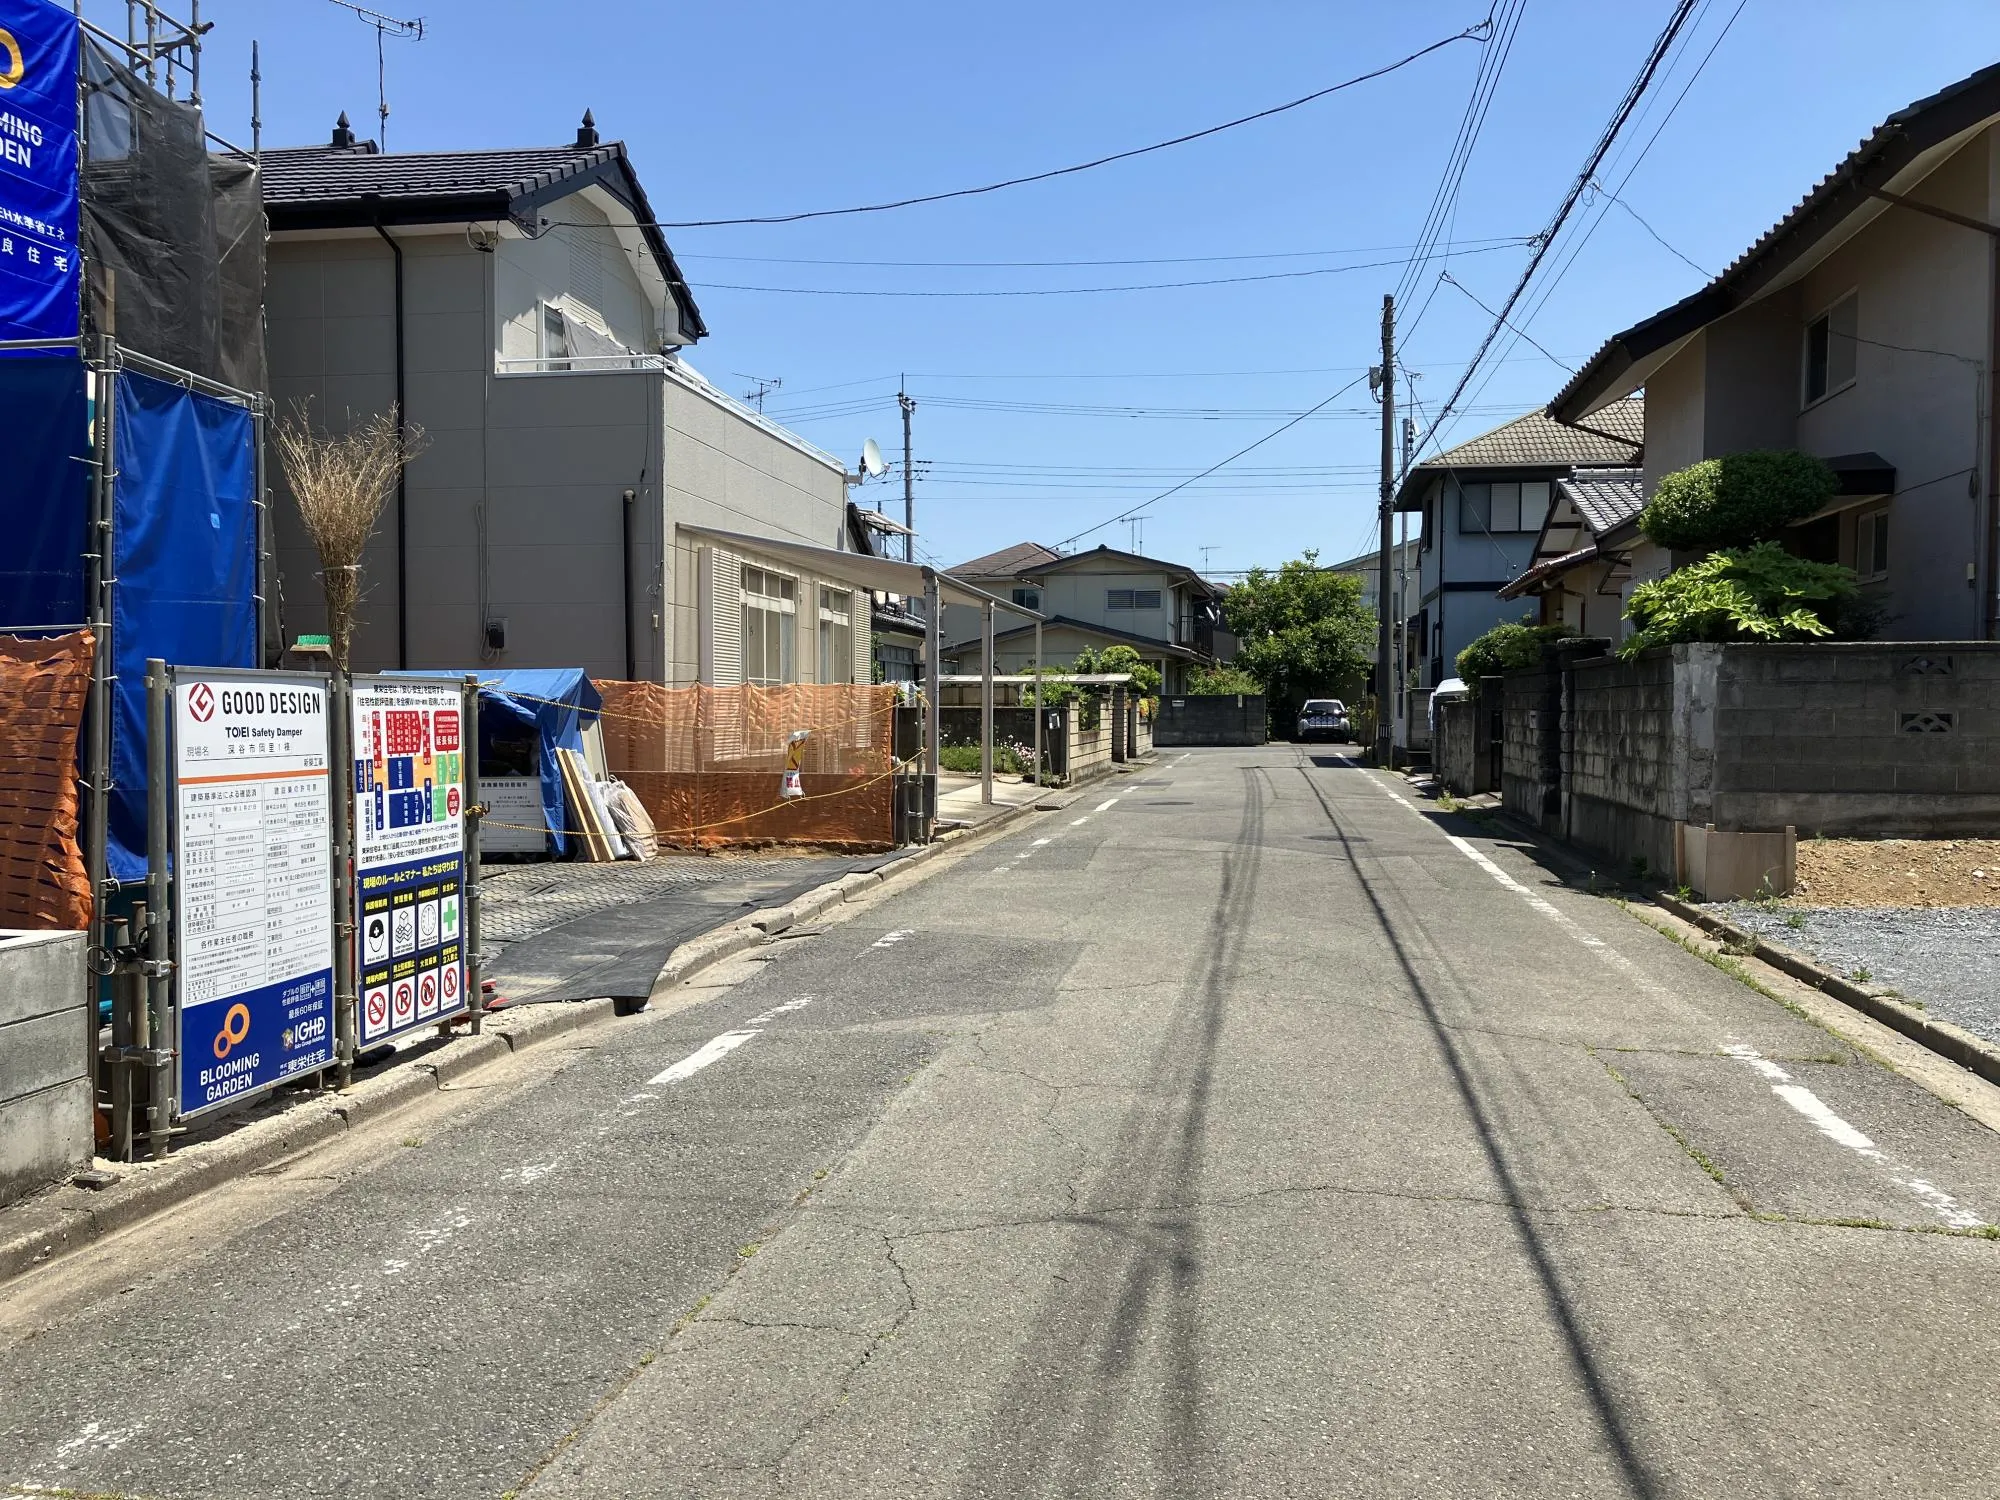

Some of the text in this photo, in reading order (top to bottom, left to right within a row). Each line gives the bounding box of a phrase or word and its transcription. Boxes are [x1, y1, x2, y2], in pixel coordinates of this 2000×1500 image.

[222, 690, 321, 715] GOOD DESIGN
[251, 728, 275, 739] Safety
[276, 728, 303, 738] Damper
[186, 746, 210, 757] 現場名
[303, 756, 324, 767] 新築工事
[363, 859, 459, 889] 現場のルールとマナー 私たちは守ります
[288, 999, 324, 1020] 最長60年保証
[200, 1052, 260, 1086] BLOOMING
[287, 1048, 326, 1073] 東栄住宅
[206, 1072, 253, 1102] GARDEN
